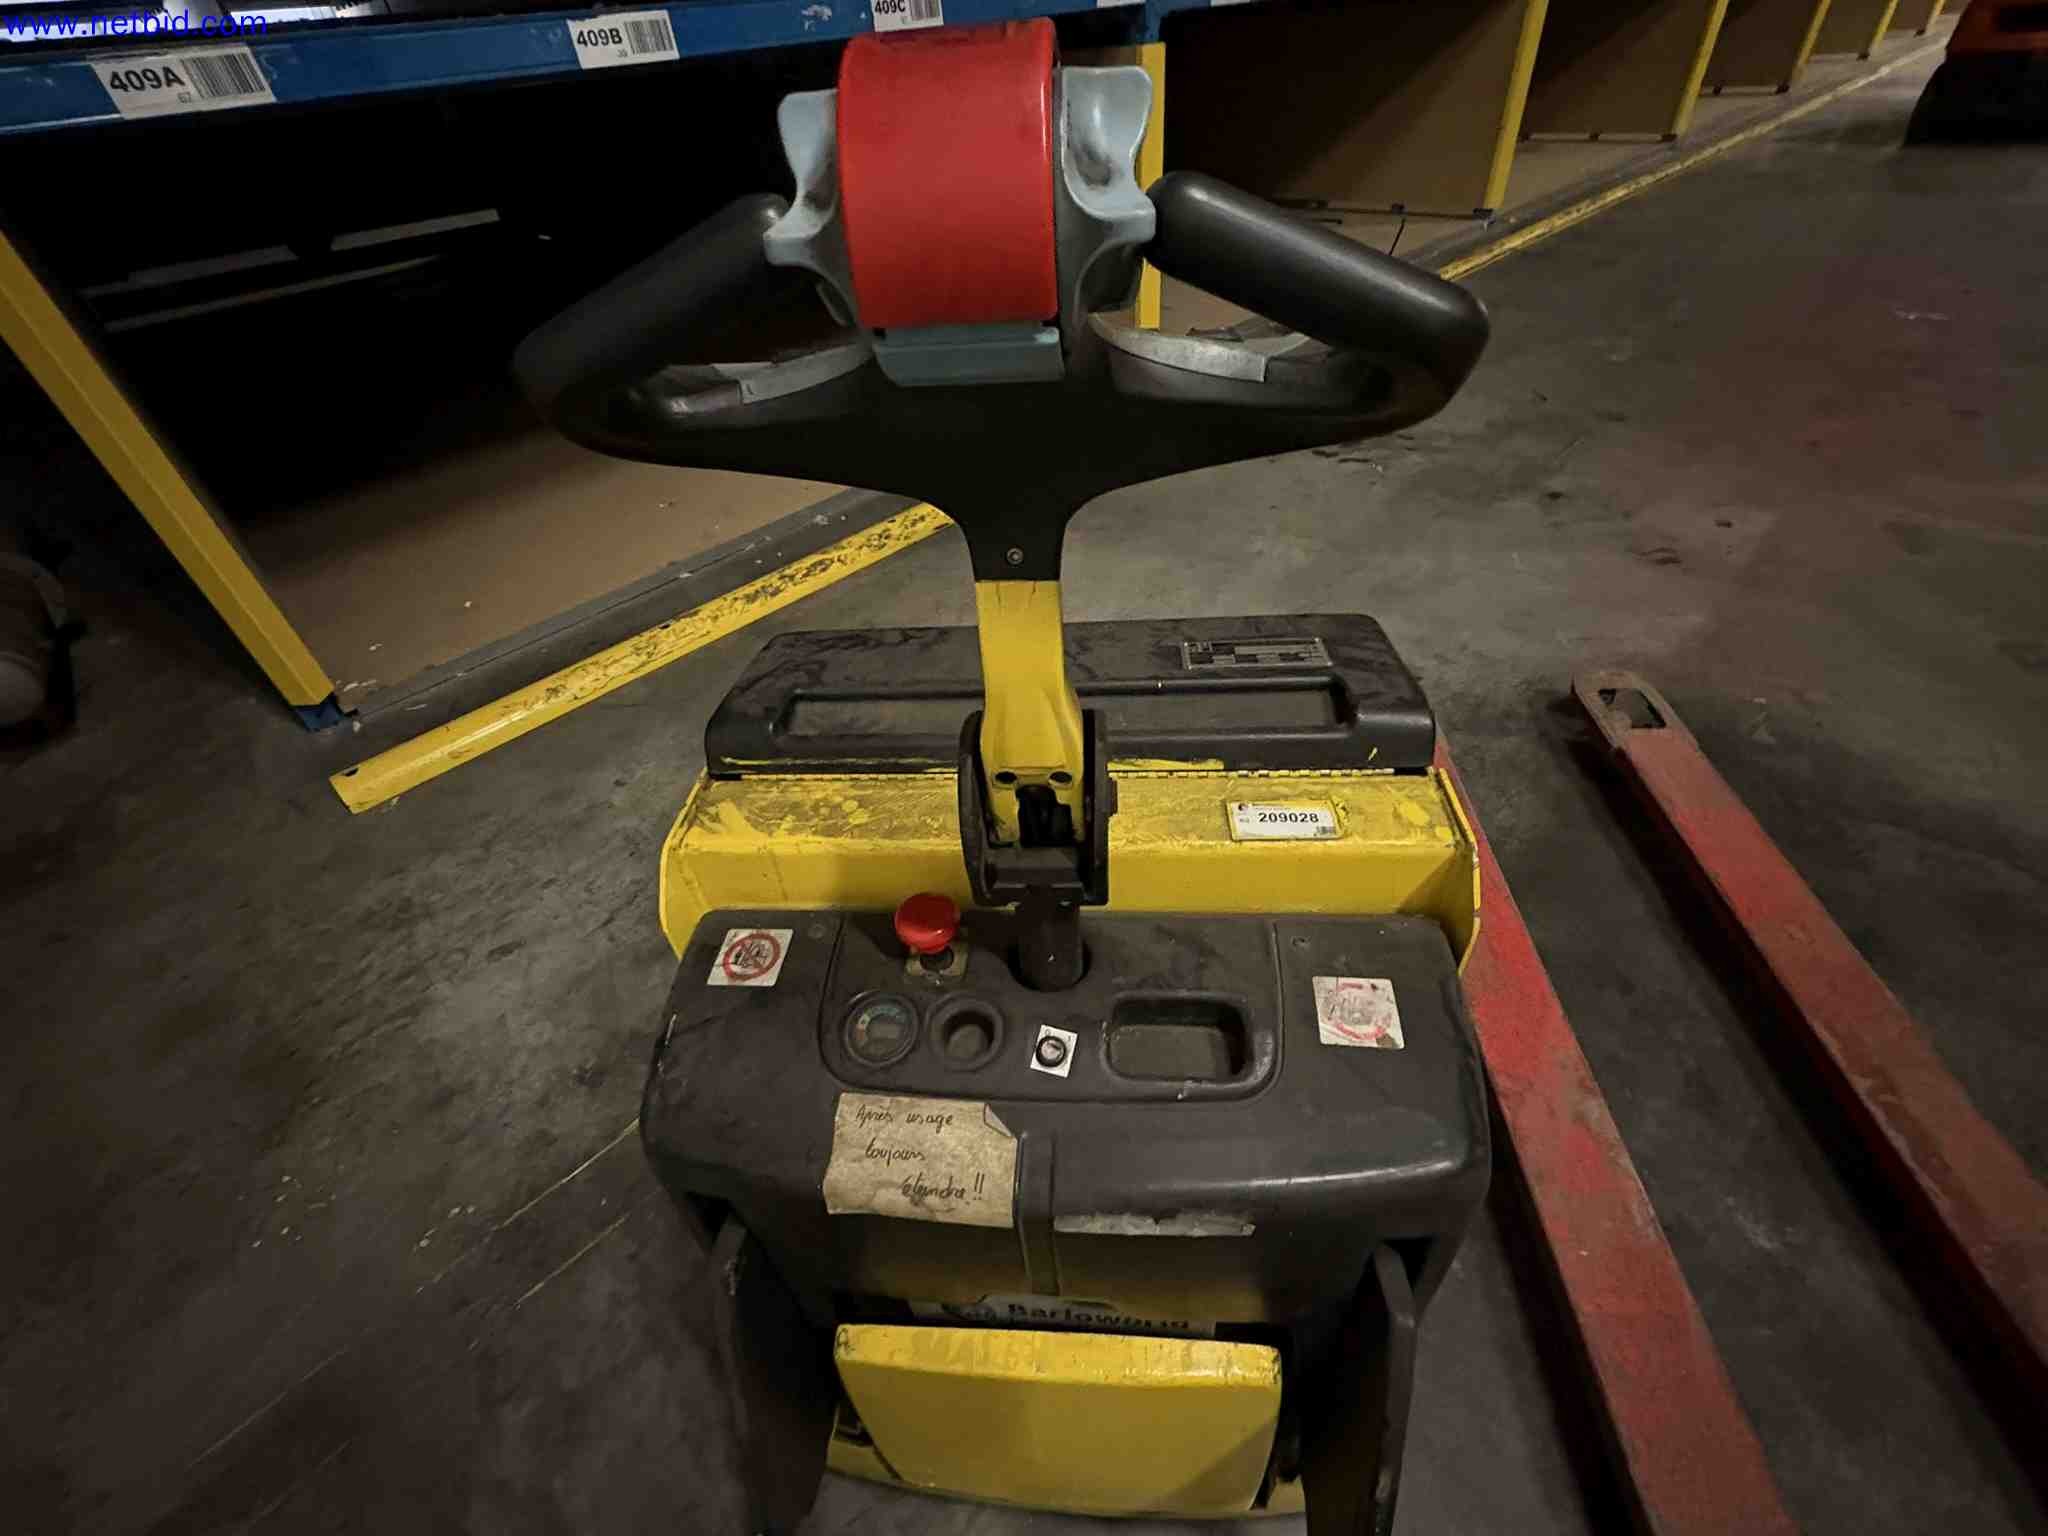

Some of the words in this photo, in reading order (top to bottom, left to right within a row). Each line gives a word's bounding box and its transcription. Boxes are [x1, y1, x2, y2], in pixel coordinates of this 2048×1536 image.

[874, 0, 906, 14] 409C
[576, 27, 622, 47] 409B
[109, 66, 185, 92] 409A
[1258, 812, 1319, 823] 209028
[905, 1111, 954, 1134] usage
[865, 1136, 926, 1167] toujours
